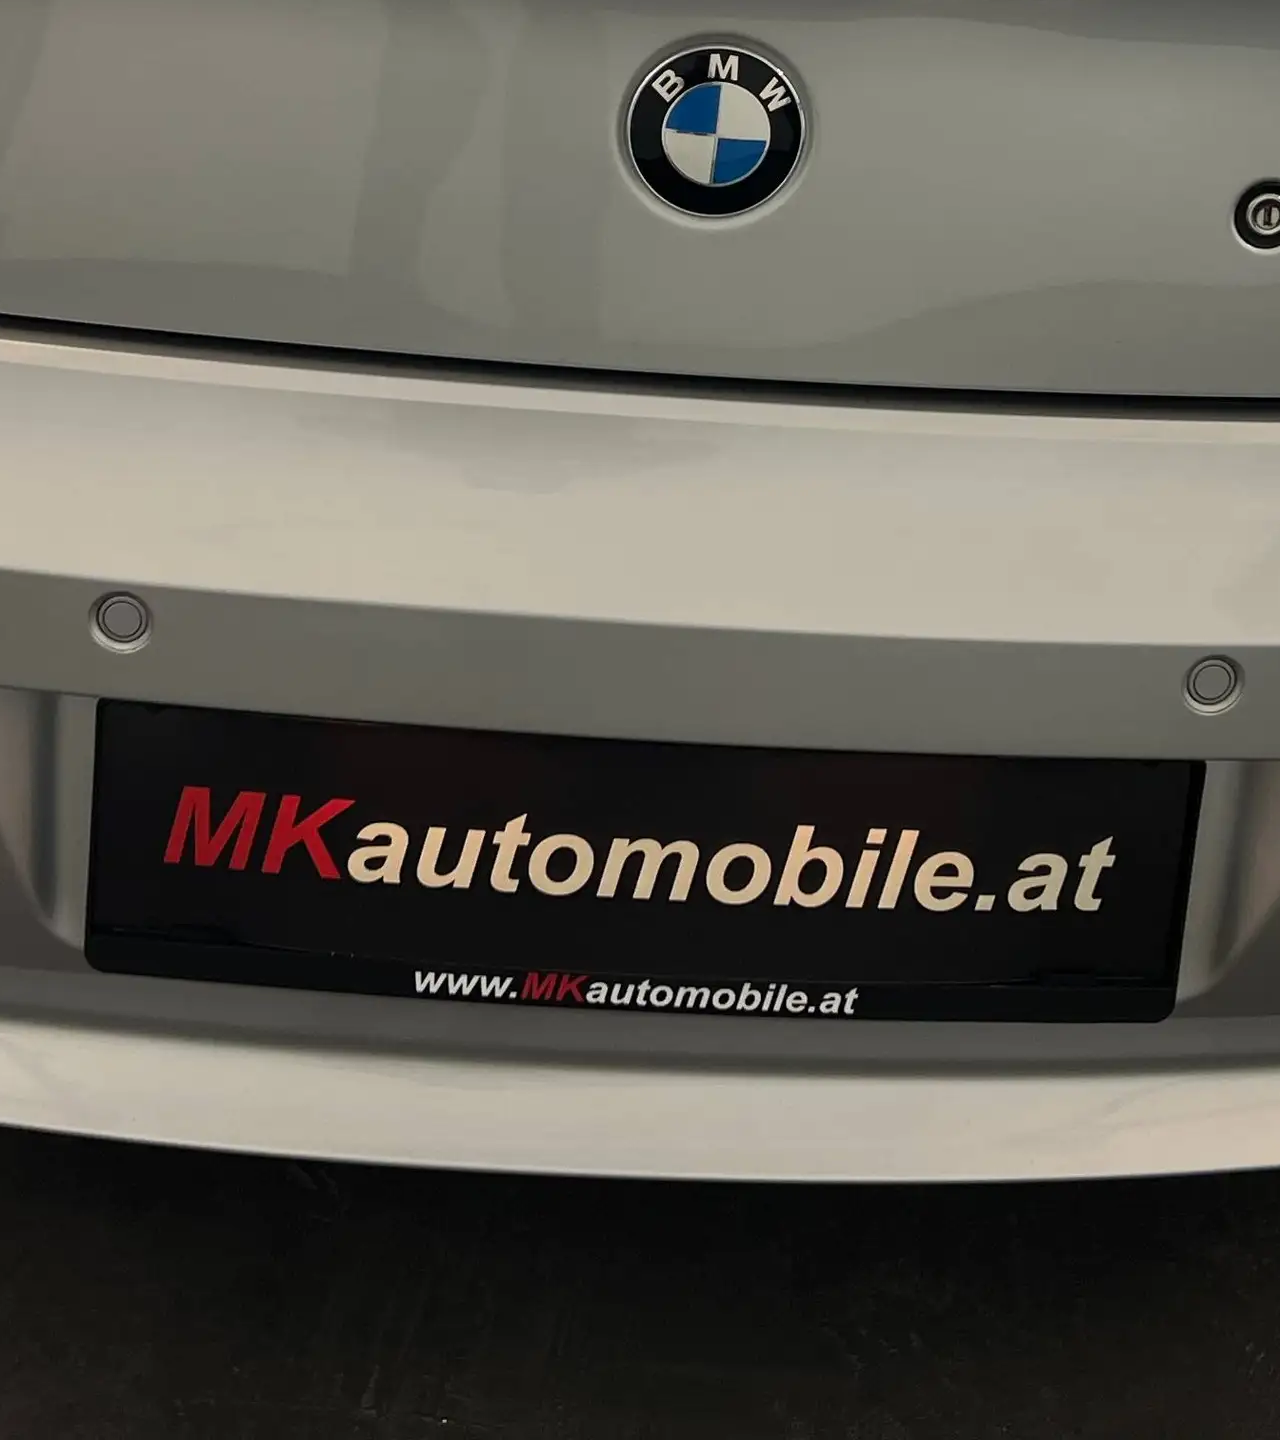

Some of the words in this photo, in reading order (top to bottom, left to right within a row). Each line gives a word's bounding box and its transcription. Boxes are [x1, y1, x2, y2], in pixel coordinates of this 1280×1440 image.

[651, 53, 791, 112] BMW
[164, 786, 1117, 913] MKautomobile.at
[415, 971, 859, 1015] www.MKautomobile.at
